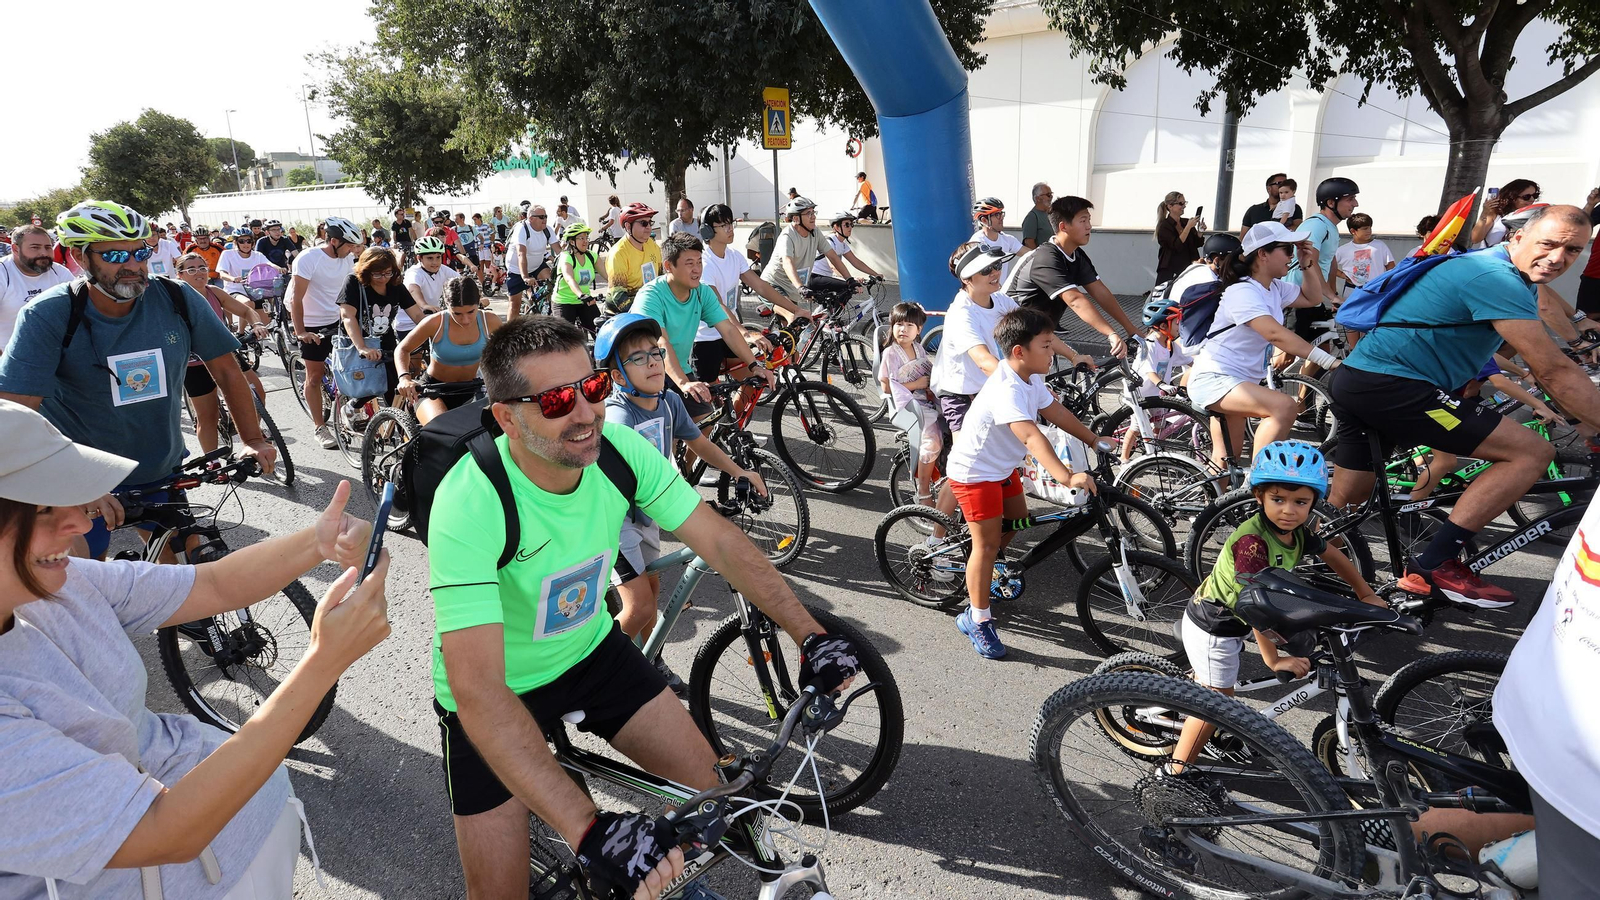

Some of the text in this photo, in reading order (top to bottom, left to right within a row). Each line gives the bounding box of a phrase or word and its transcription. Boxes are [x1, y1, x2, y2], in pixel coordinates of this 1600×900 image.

[768, 138, 788, 146] PEATONES
[1469, 520, 1552, 573] ROCKRIDER
[1273, 690, 1309, 716] SCAMP
[1396, 737, 1437, 755] SCALPEL
[1093, 845, 1134, 876] BARZO
